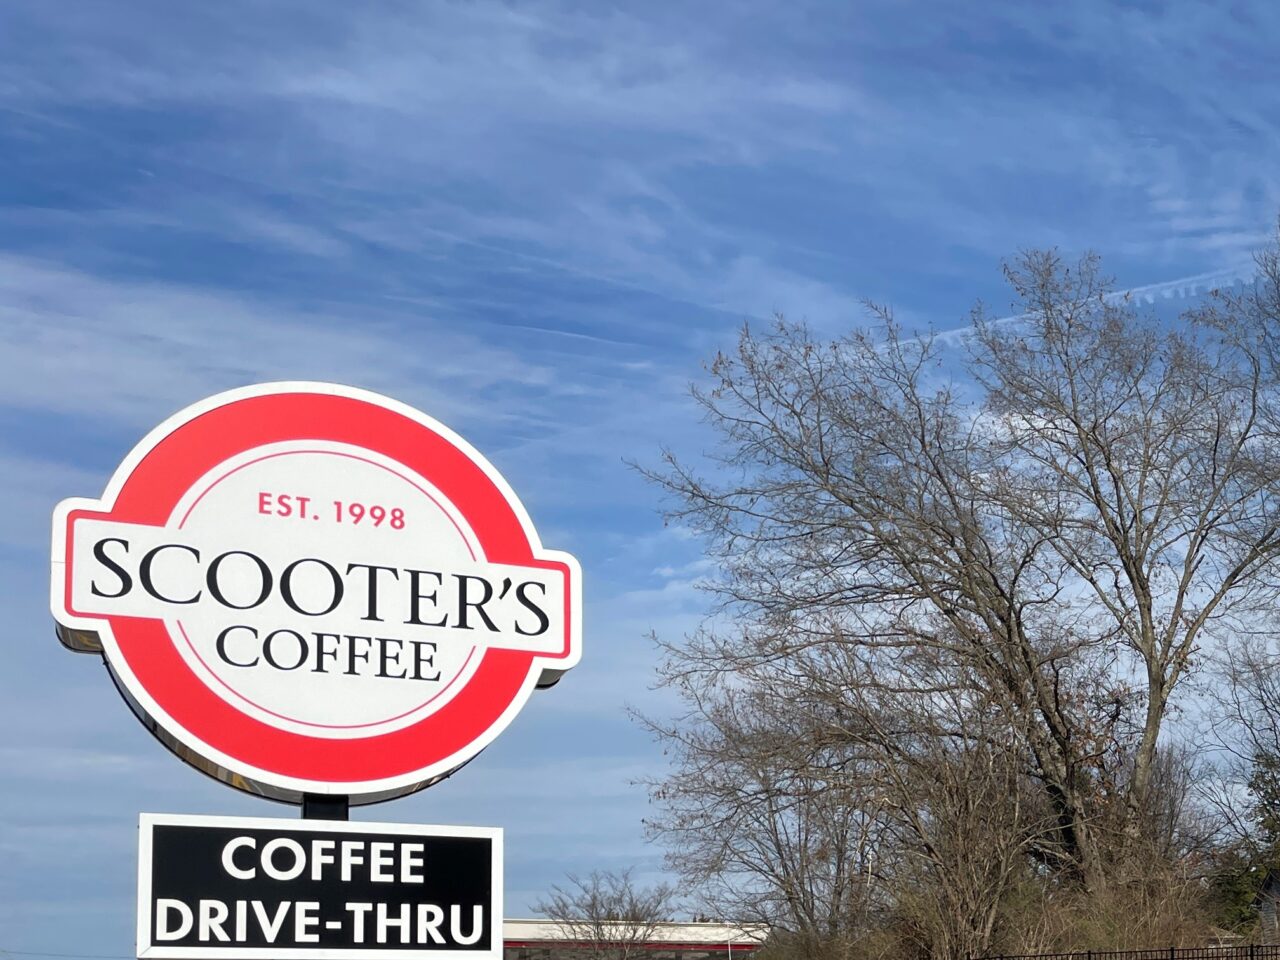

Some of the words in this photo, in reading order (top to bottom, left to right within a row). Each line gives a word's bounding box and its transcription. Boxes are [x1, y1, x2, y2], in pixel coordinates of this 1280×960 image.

[258, 492, 319, 521] EST.
[333, 501, 406, 530] 1998
[90, 537, 551, 636] SCOOTER'S
[215, 625, 441, 683] COFFEE
[221, 836, 425, 884] COFFEE
[155, 899, 484, 946] DRIVE-THRU
